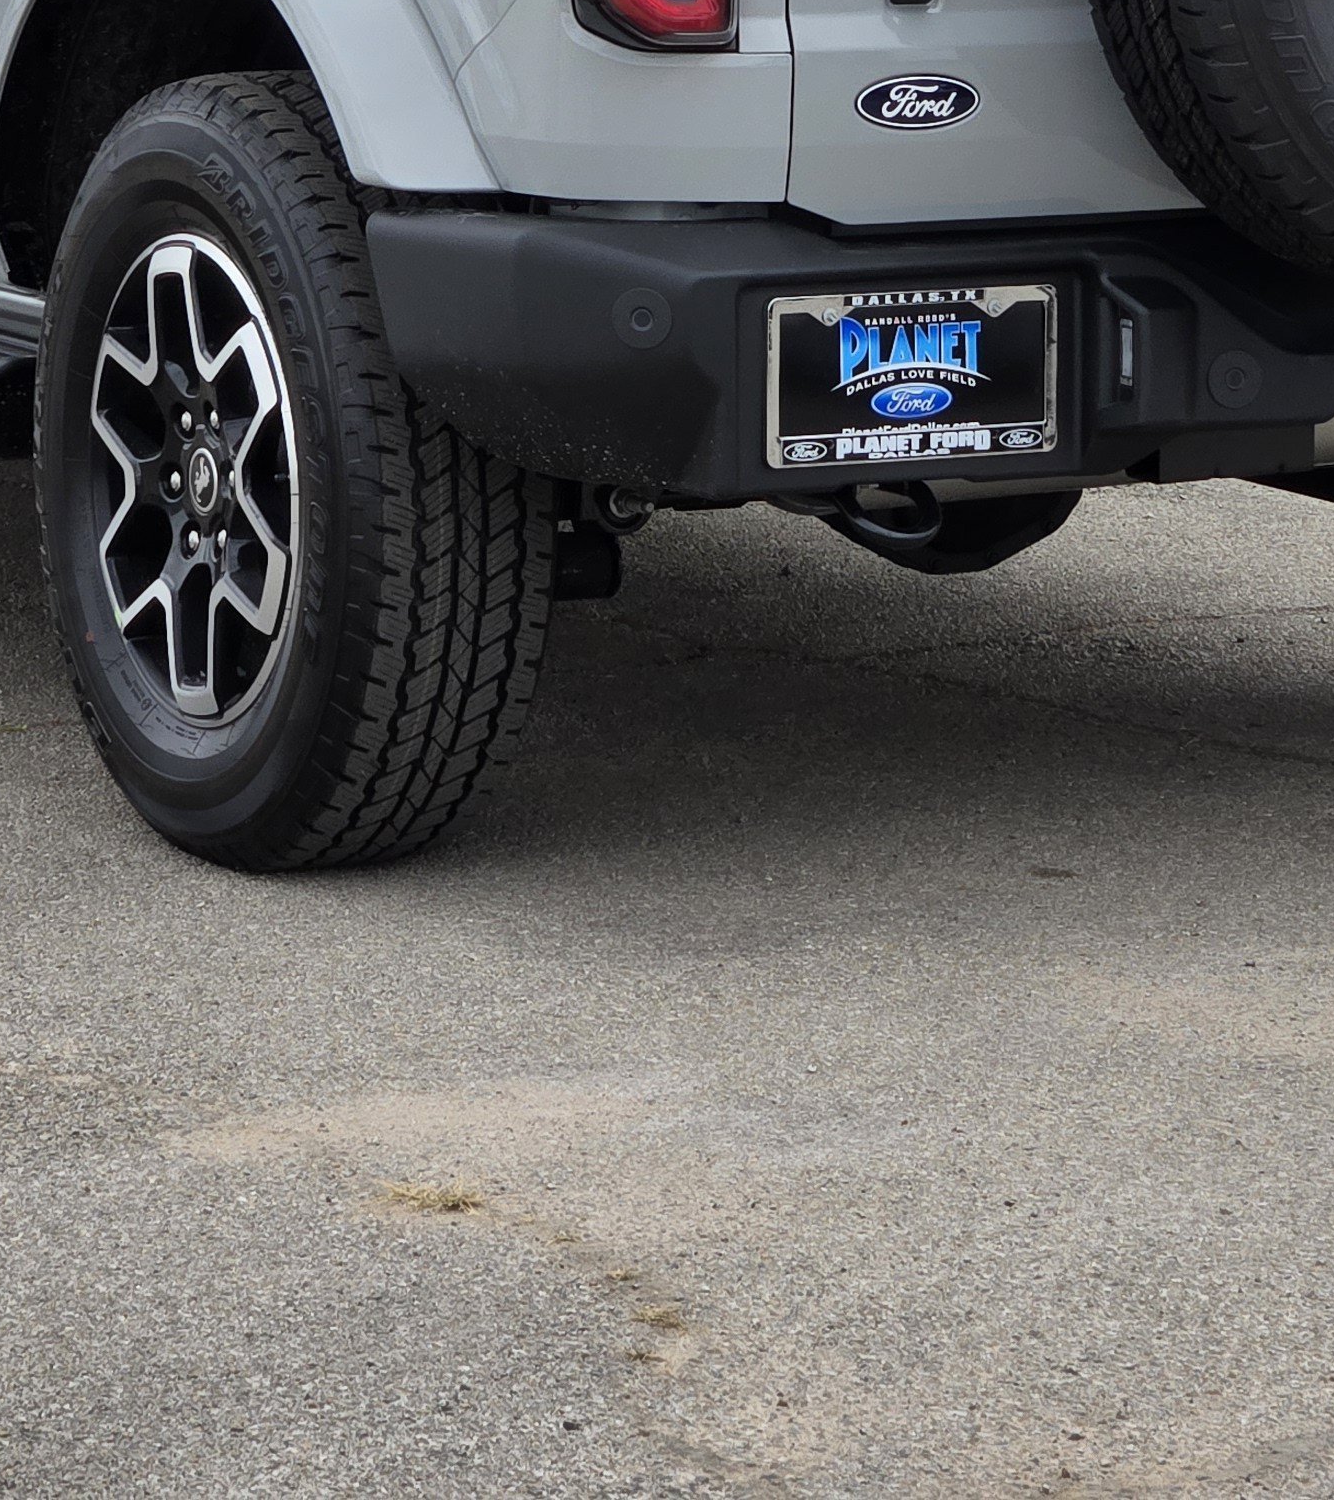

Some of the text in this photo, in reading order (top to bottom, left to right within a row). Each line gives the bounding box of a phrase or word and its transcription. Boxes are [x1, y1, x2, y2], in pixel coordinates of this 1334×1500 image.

[881, 84, 958, 118] Ford
[950, 290, 977, 301] TX
[839, 316, 981, 384] PLANET
[846, 369, 977, 396] DALLAS LOVE FIELD
[886, 387, 937, 413] Ford
[791, 430, 1035, 460] Ford PLANET FORD Ford
